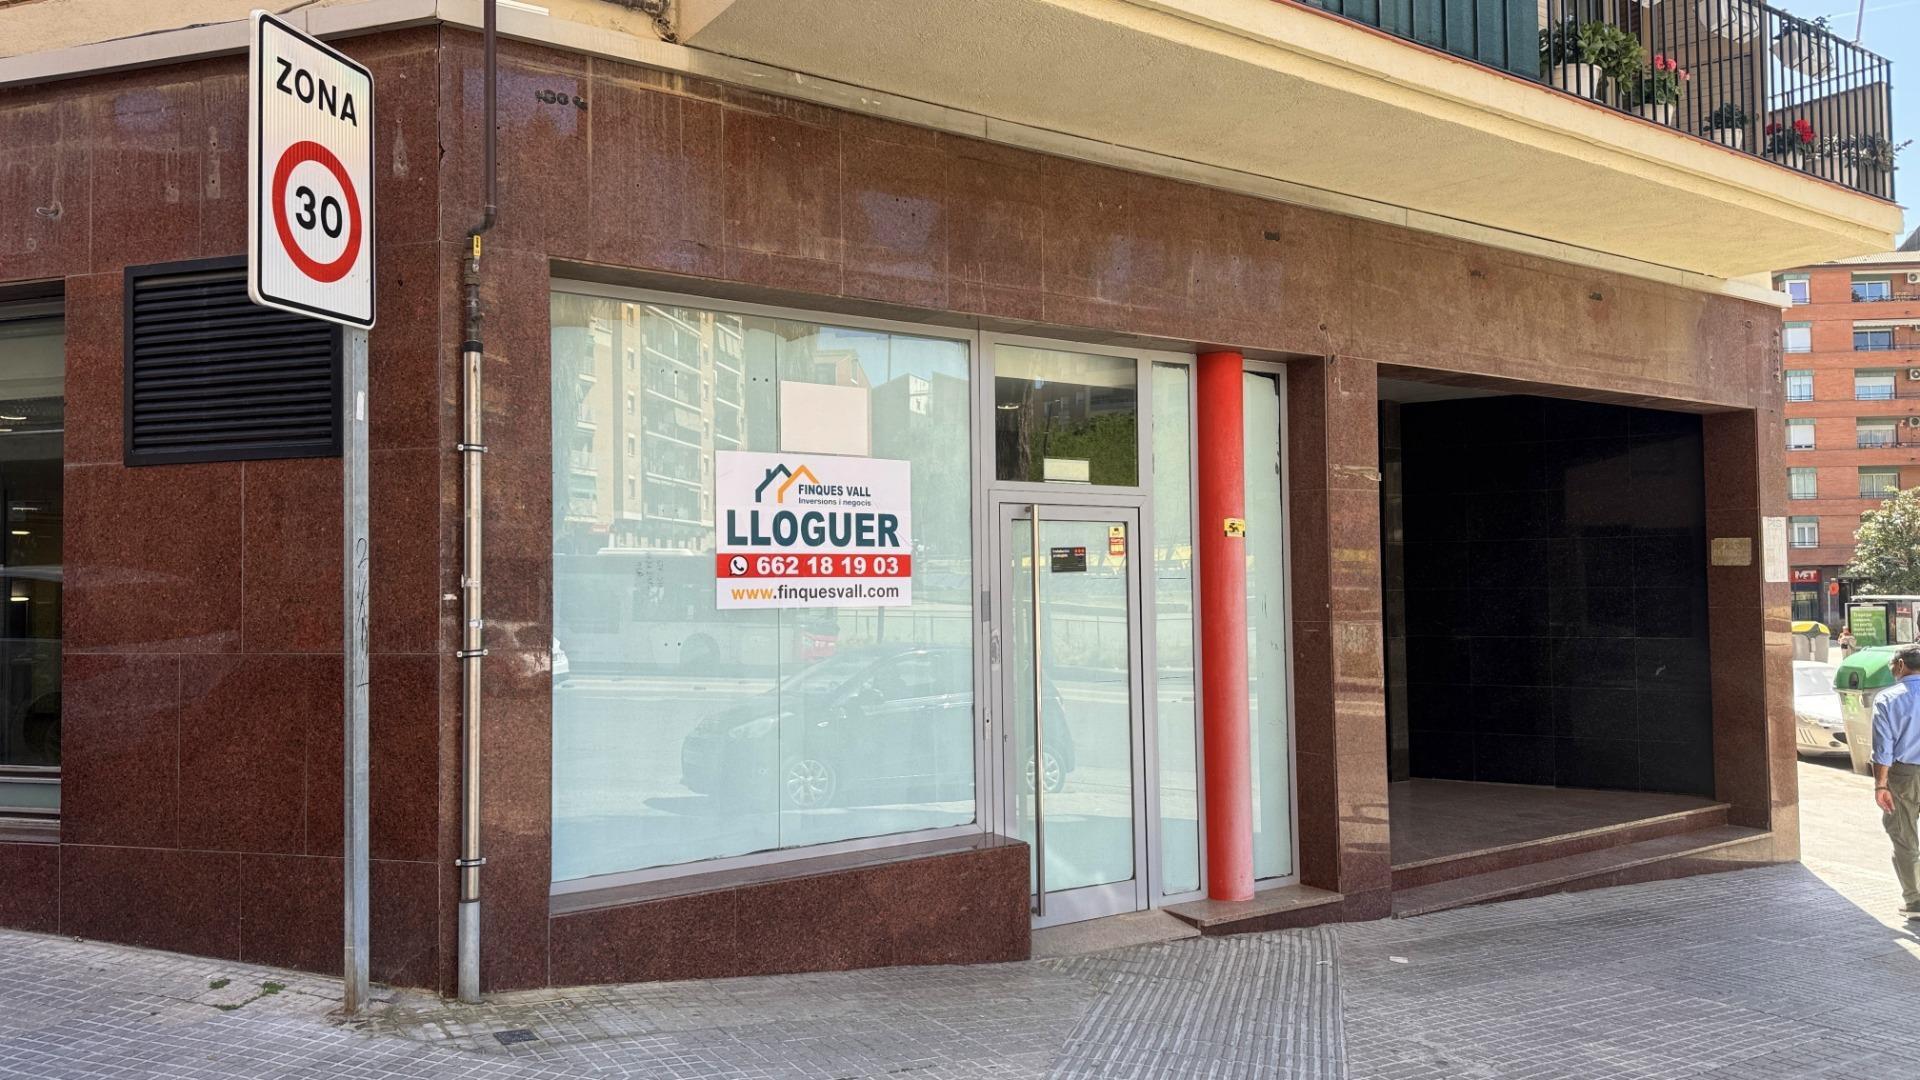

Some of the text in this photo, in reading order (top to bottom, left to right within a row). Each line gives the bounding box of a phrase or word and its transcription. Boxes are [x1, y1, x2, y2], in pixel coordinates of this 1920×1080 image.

[276, 56, 357, 127] ZONA
[295, 186, 343, 239] 30
[798, 484, 871, 497] FINQUES VALL
[798, 497, 837, 505] Inversions
[842, 499, 871, 507] negocis
[727, 509, 900, 547] LLOGUER
[756, 556, 899, 575] 662 18 19 03
[731, 584, 899, 602] www.finquesvall.com
